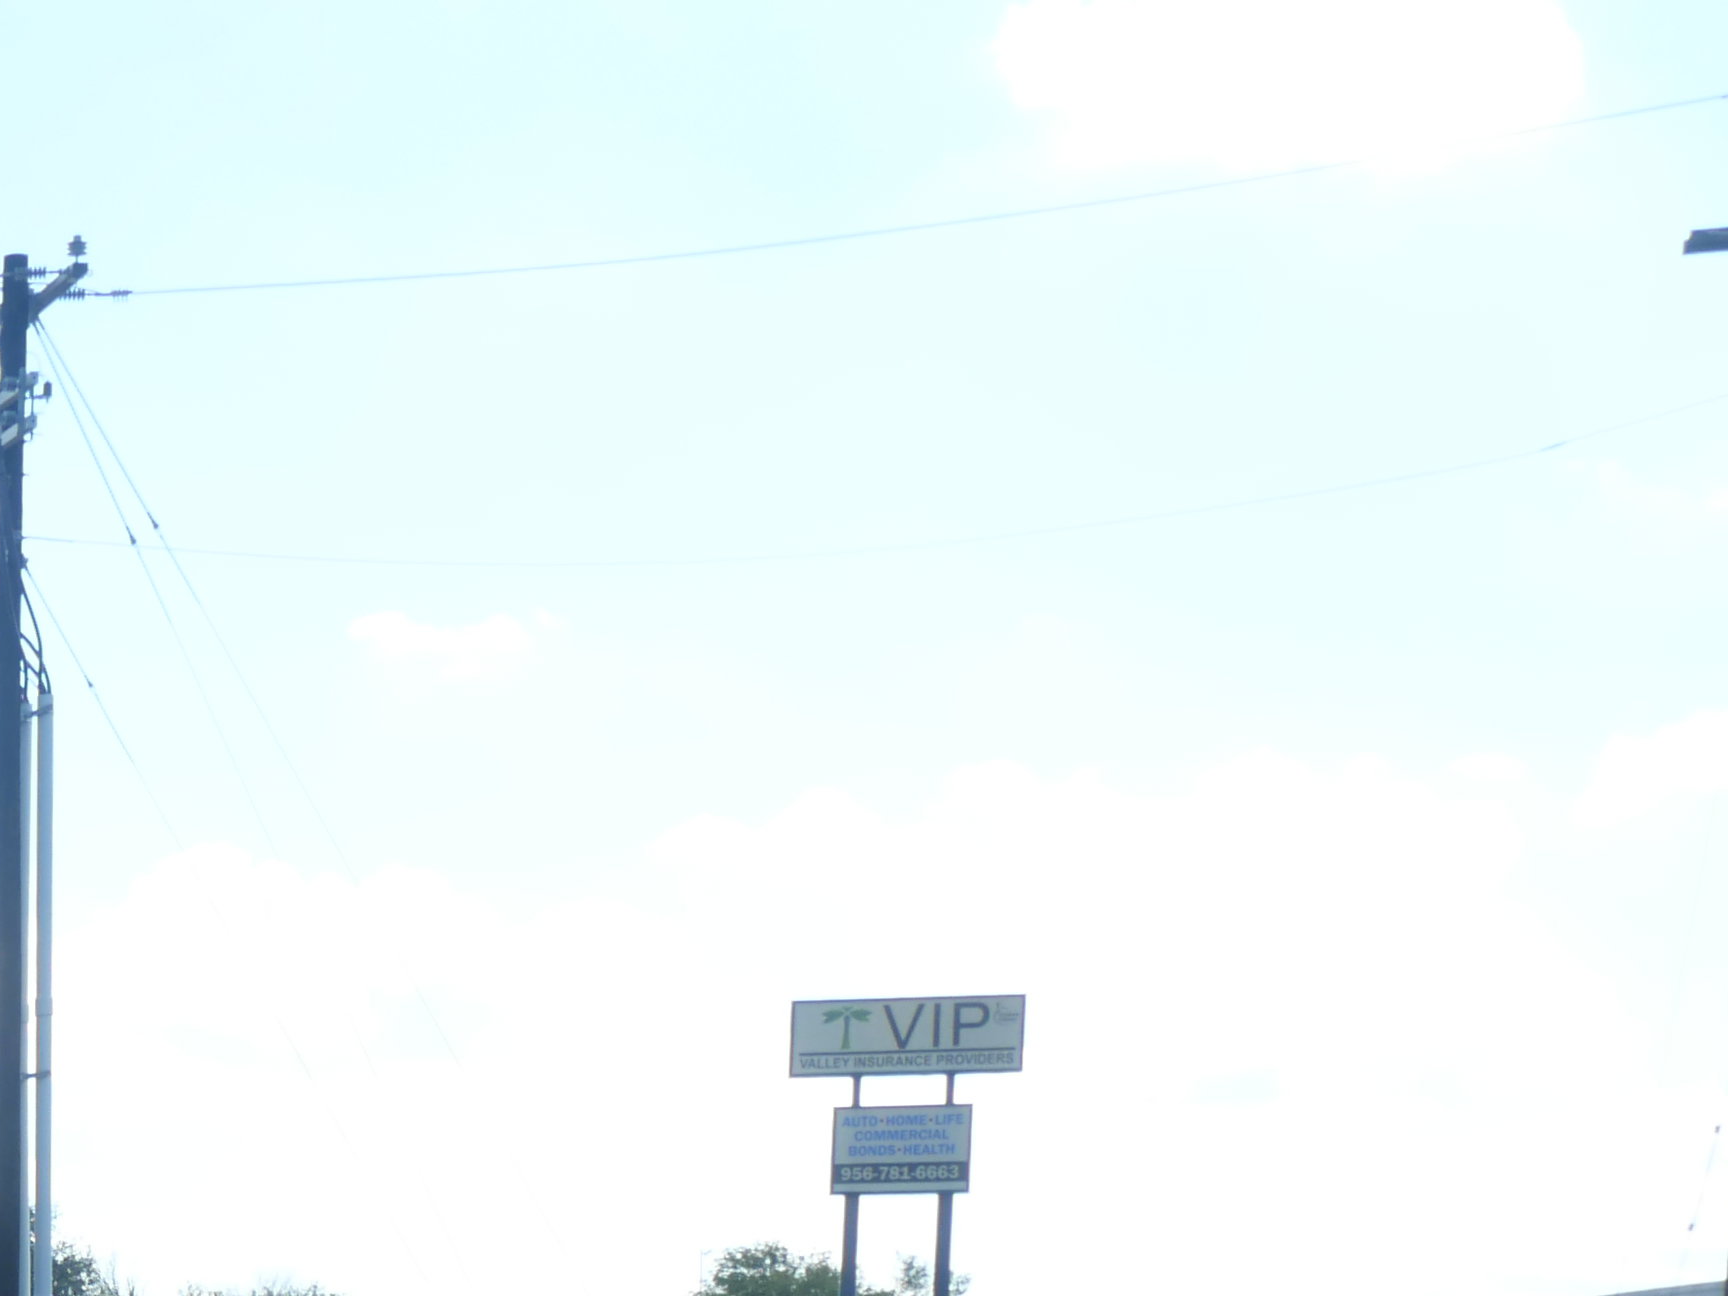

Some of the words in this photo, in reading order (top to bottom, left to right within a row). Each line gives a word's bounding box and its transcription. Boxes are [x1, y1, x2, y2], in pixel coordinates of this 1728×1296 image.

[884, 1002, 990, 1050] VIP
[800, 1056, 849, 1069] VALLEY
[854, 1054, 931, 1068] INSURANCE
[936, 1052, 1014, 1066] PROVIDERS
[854, 1129, 949, 1141] COMMERCIAL
[841, 1164, 959, 1181] 956-781-6663
